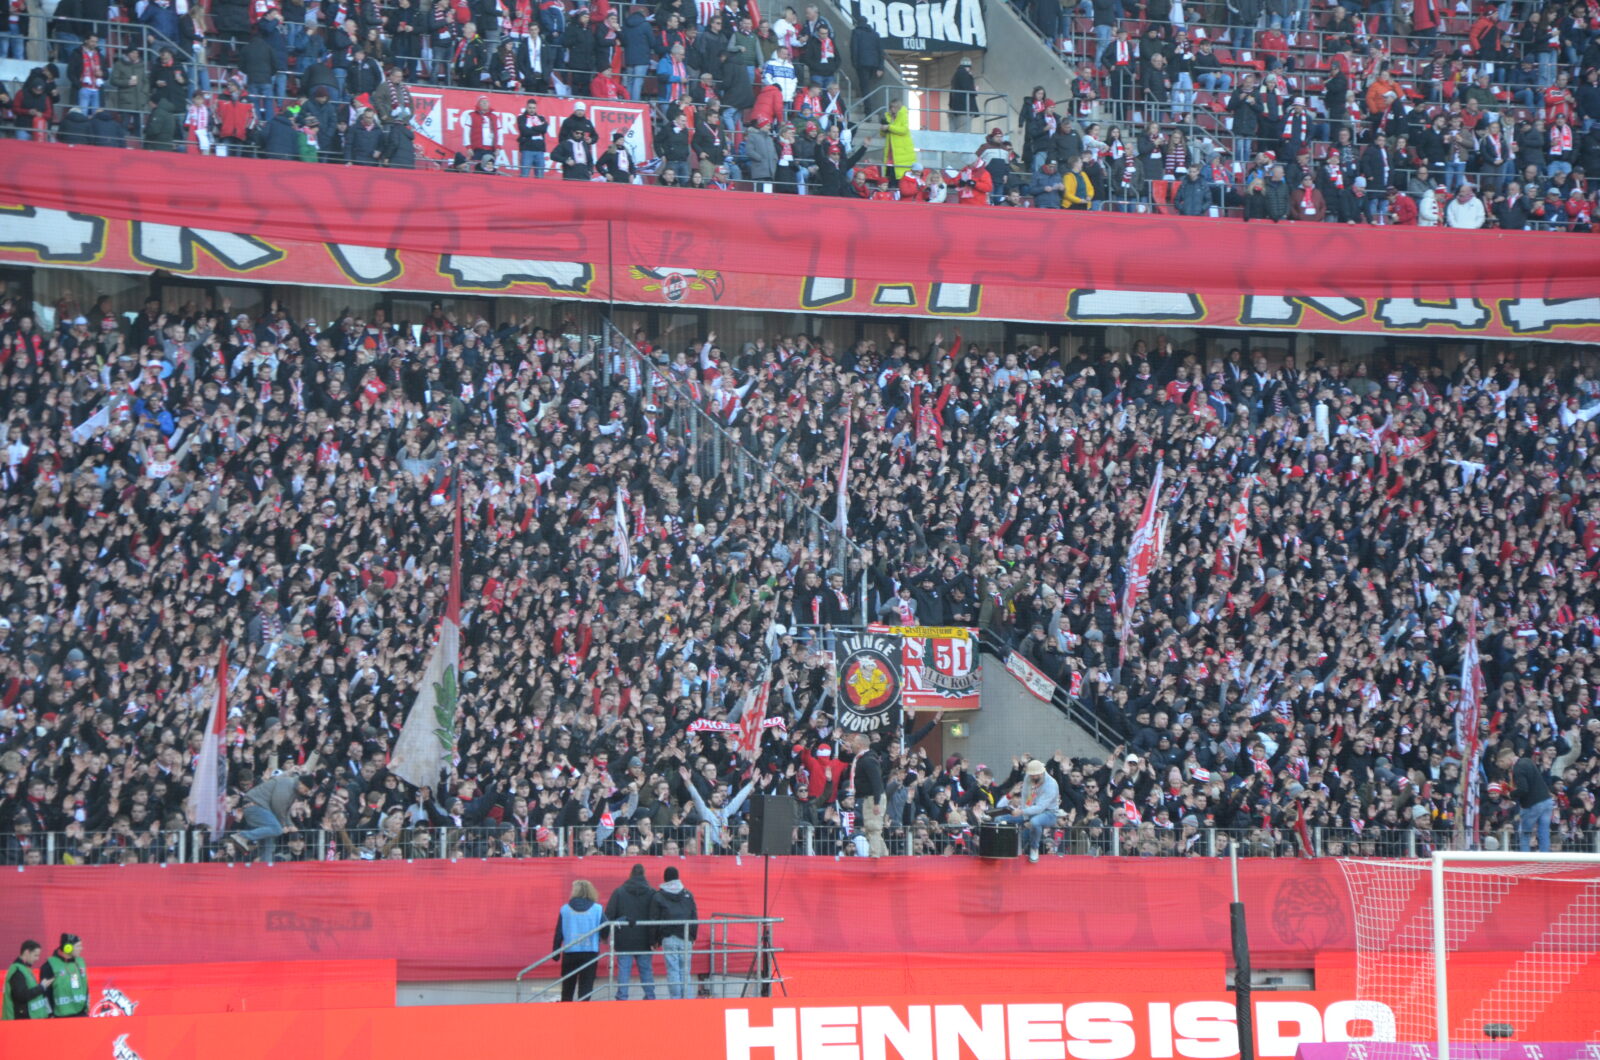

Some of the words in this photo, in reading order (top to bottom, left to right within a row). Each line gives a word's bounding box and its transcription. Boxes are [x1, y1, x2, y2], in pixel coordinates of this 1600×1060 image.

[842, 634, 896, 657] JUNGE
[936, 645, 968, 670] 51
[840, 711, 891, 733] HORDE
[725, 1000, 1135, 1060] HENNES
[1148, 1000, 1239, 1059] IS
[1255, 1000, 1397, 1059] DO
